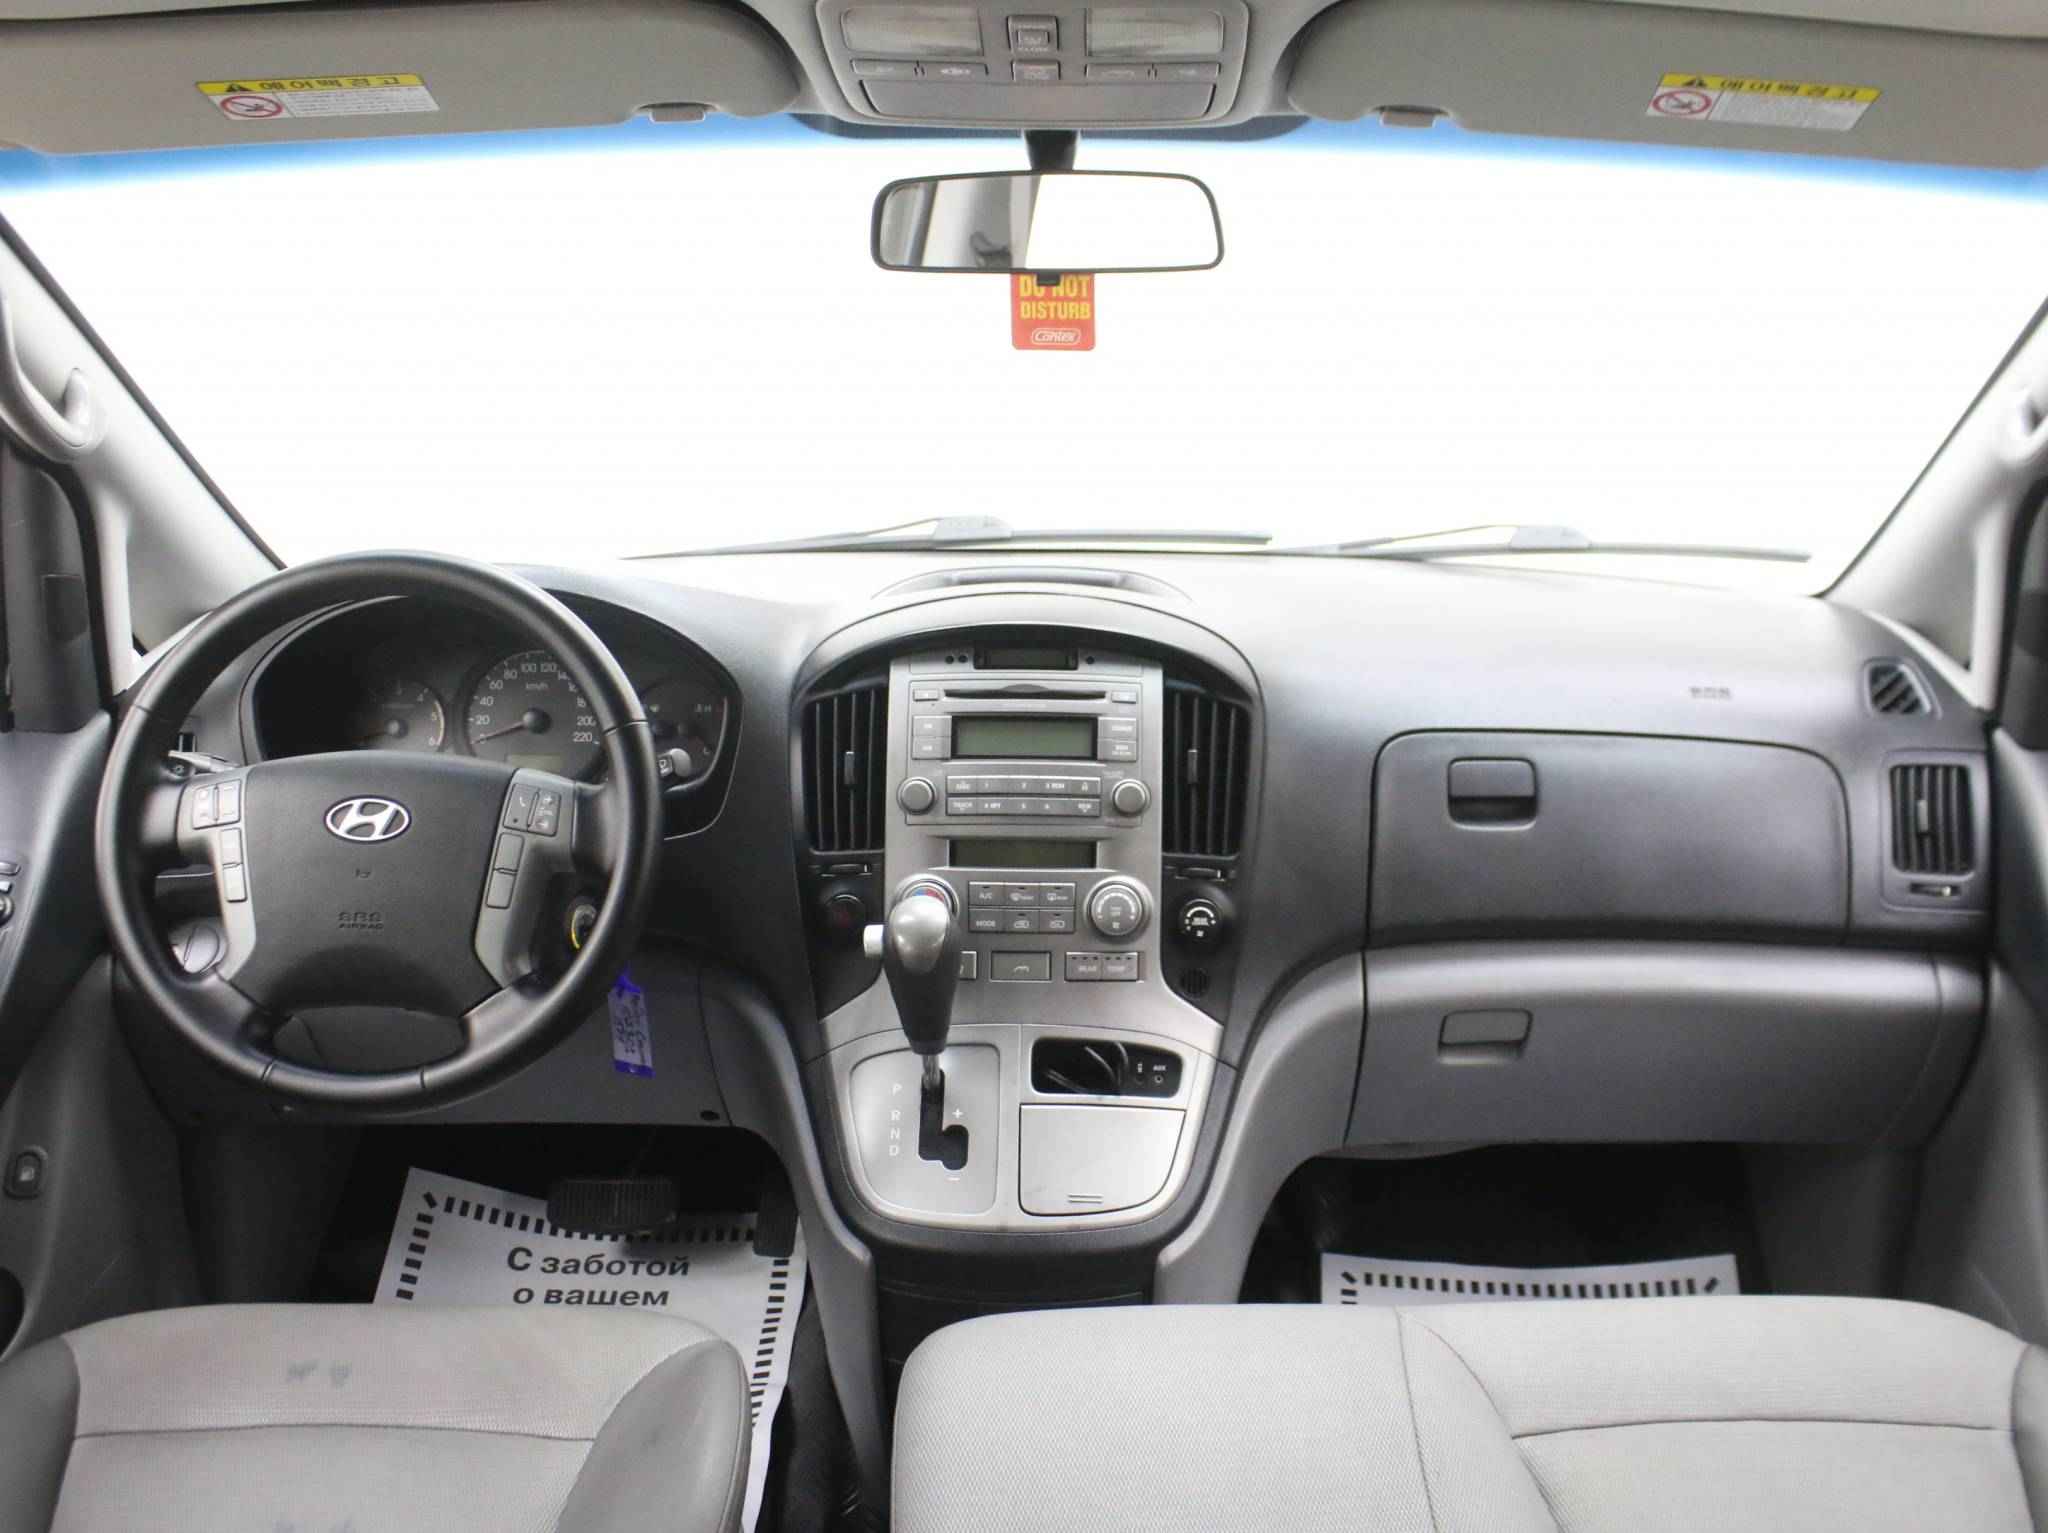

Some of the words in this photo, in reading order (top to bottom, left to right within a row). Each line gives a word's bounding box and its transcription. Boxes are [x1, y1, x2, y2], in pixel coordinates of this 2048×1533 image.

[1020, 301, 1091, 320] DISTURB
[489, 679, 504, 690] 60
[480, 695, 494, 706] 40
[475, 714, 490, 725] 20
[572, 732, 593, 743] 220
[891, 1083, 903, 1096] P
[890, 1108, 901, 1121] R
[890, 1128, 900, 1140] N
[888, 1144, 899, 1156] D
[507, 1247, 533, 1271] С
[540, 1253, 691, 1276] заботой
[513, 1287, 535, 1304] о
[544, 1289, 670, 1306] вашем
